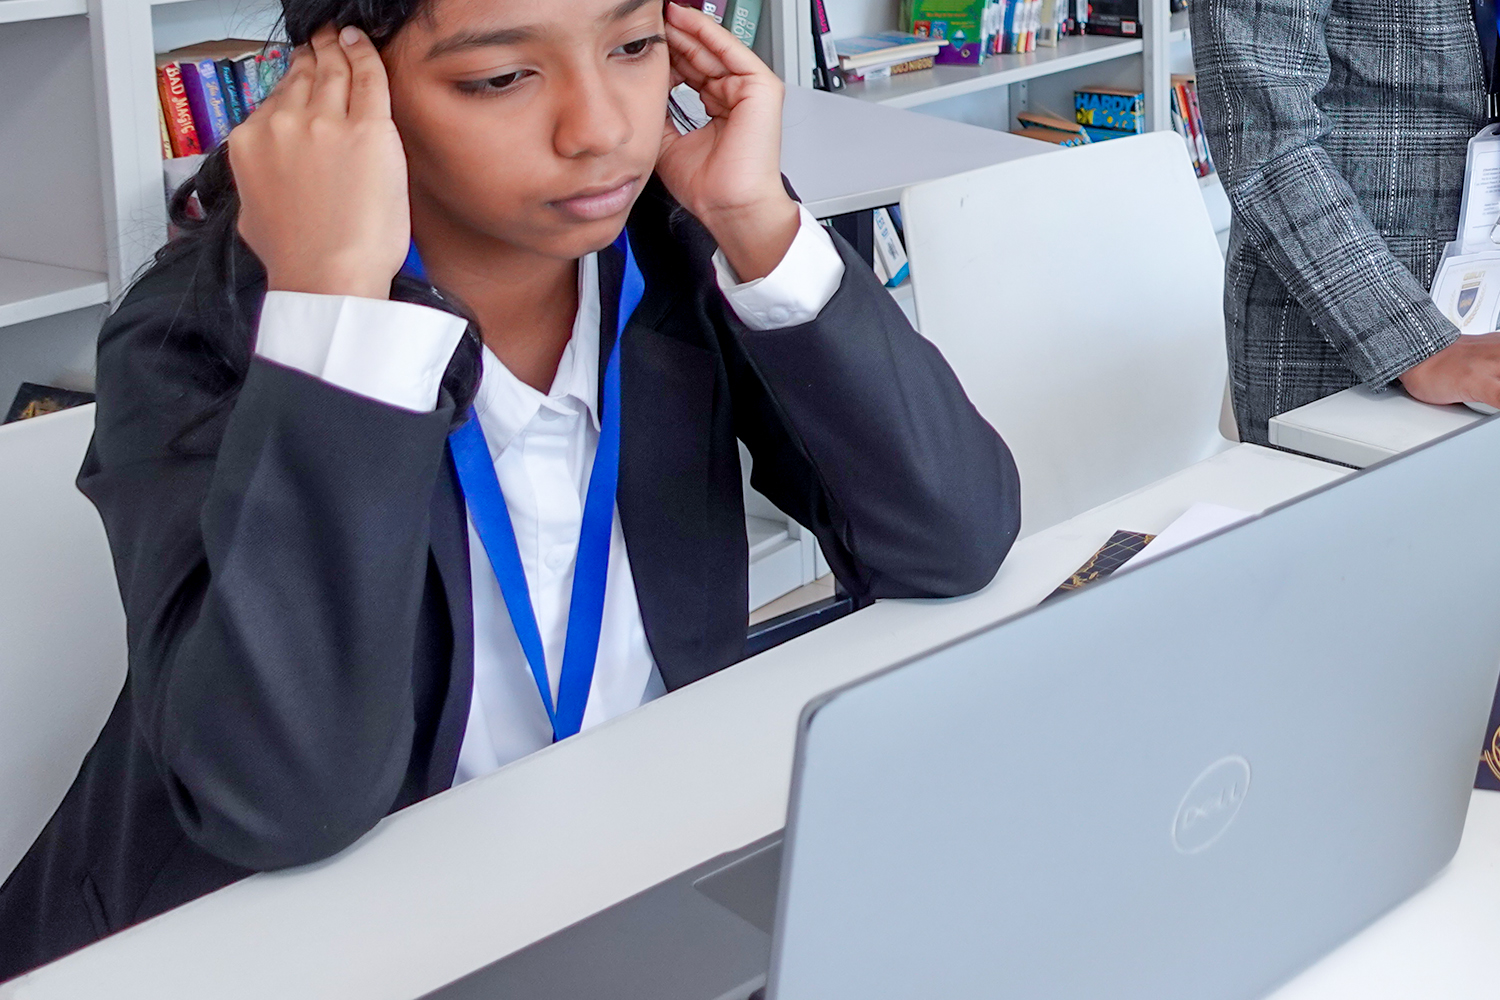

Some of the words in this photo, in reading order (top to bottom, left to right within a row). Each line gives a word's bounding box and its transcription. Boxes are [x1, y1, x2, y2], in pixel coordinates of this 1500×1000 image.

[165, 66, 185, 94] BAD
[172, 95, 195, 133] MAGIC
[1076, 93, 1135, 111] HARDY
[1094, 110, 1136, 130] BOYS
